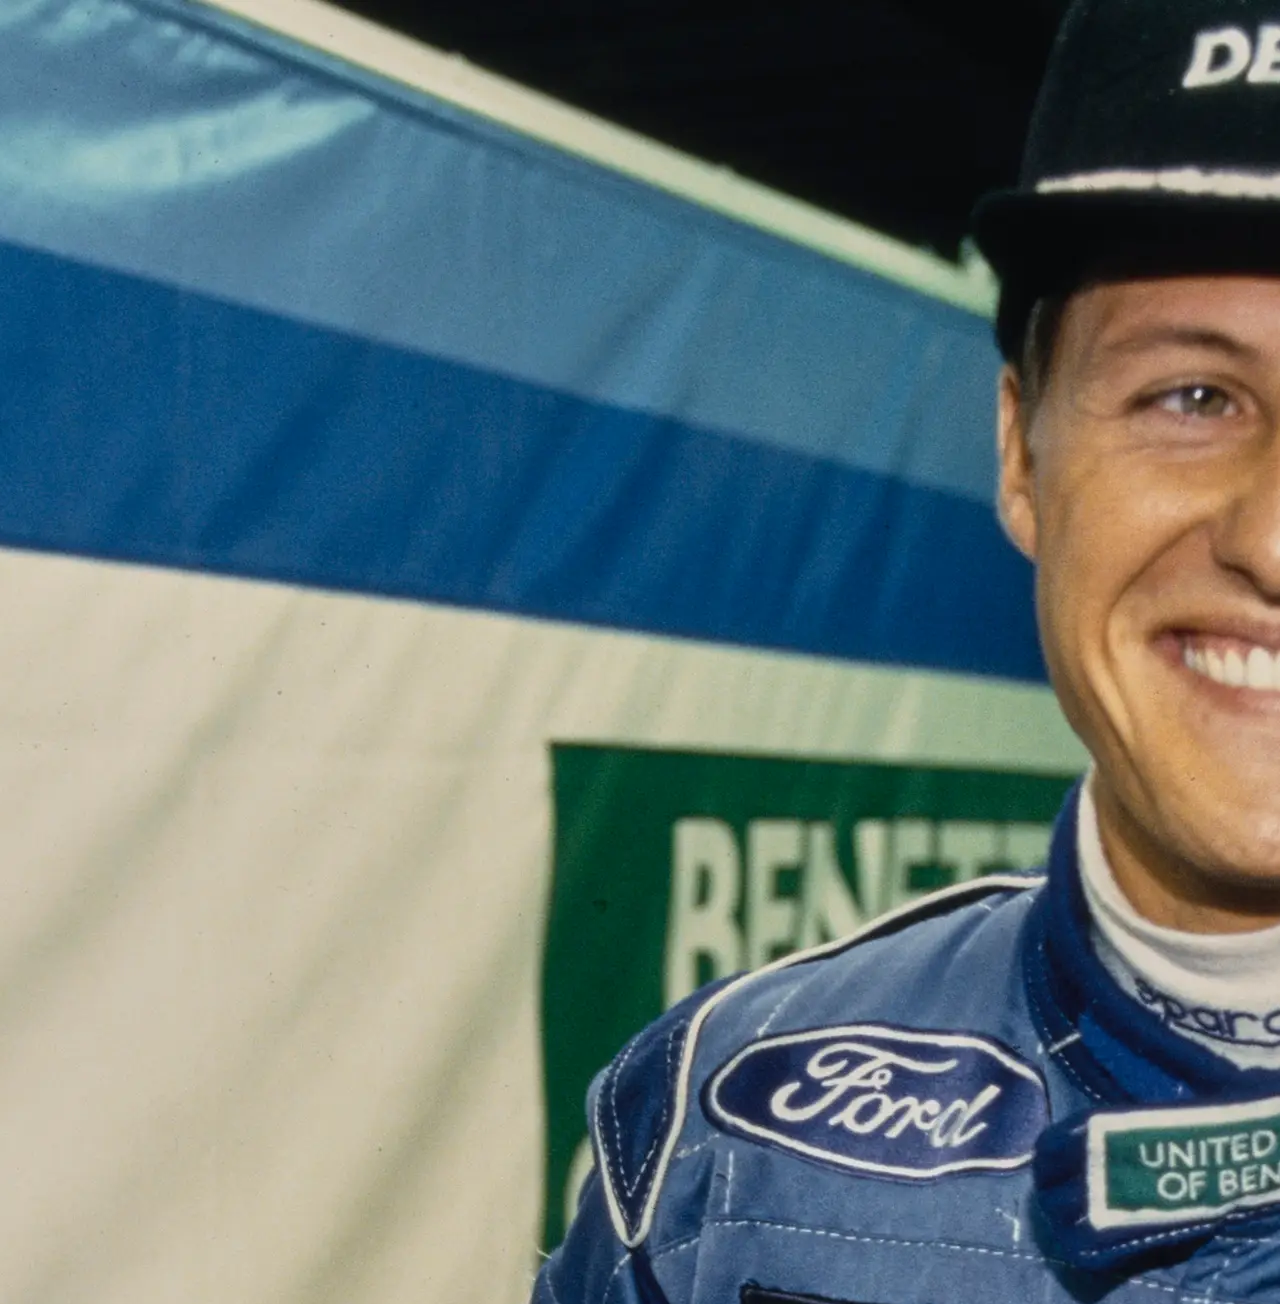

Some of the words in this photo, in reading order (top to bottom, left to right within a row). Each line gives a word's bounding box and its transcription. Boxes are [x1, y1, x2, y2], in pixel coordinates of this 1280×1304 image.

[771, 1041, 1002, 1149] Ford
[1139, 1130, 1277, 1170] UNITED
[1156, 1170, 1207, 1201] OF
